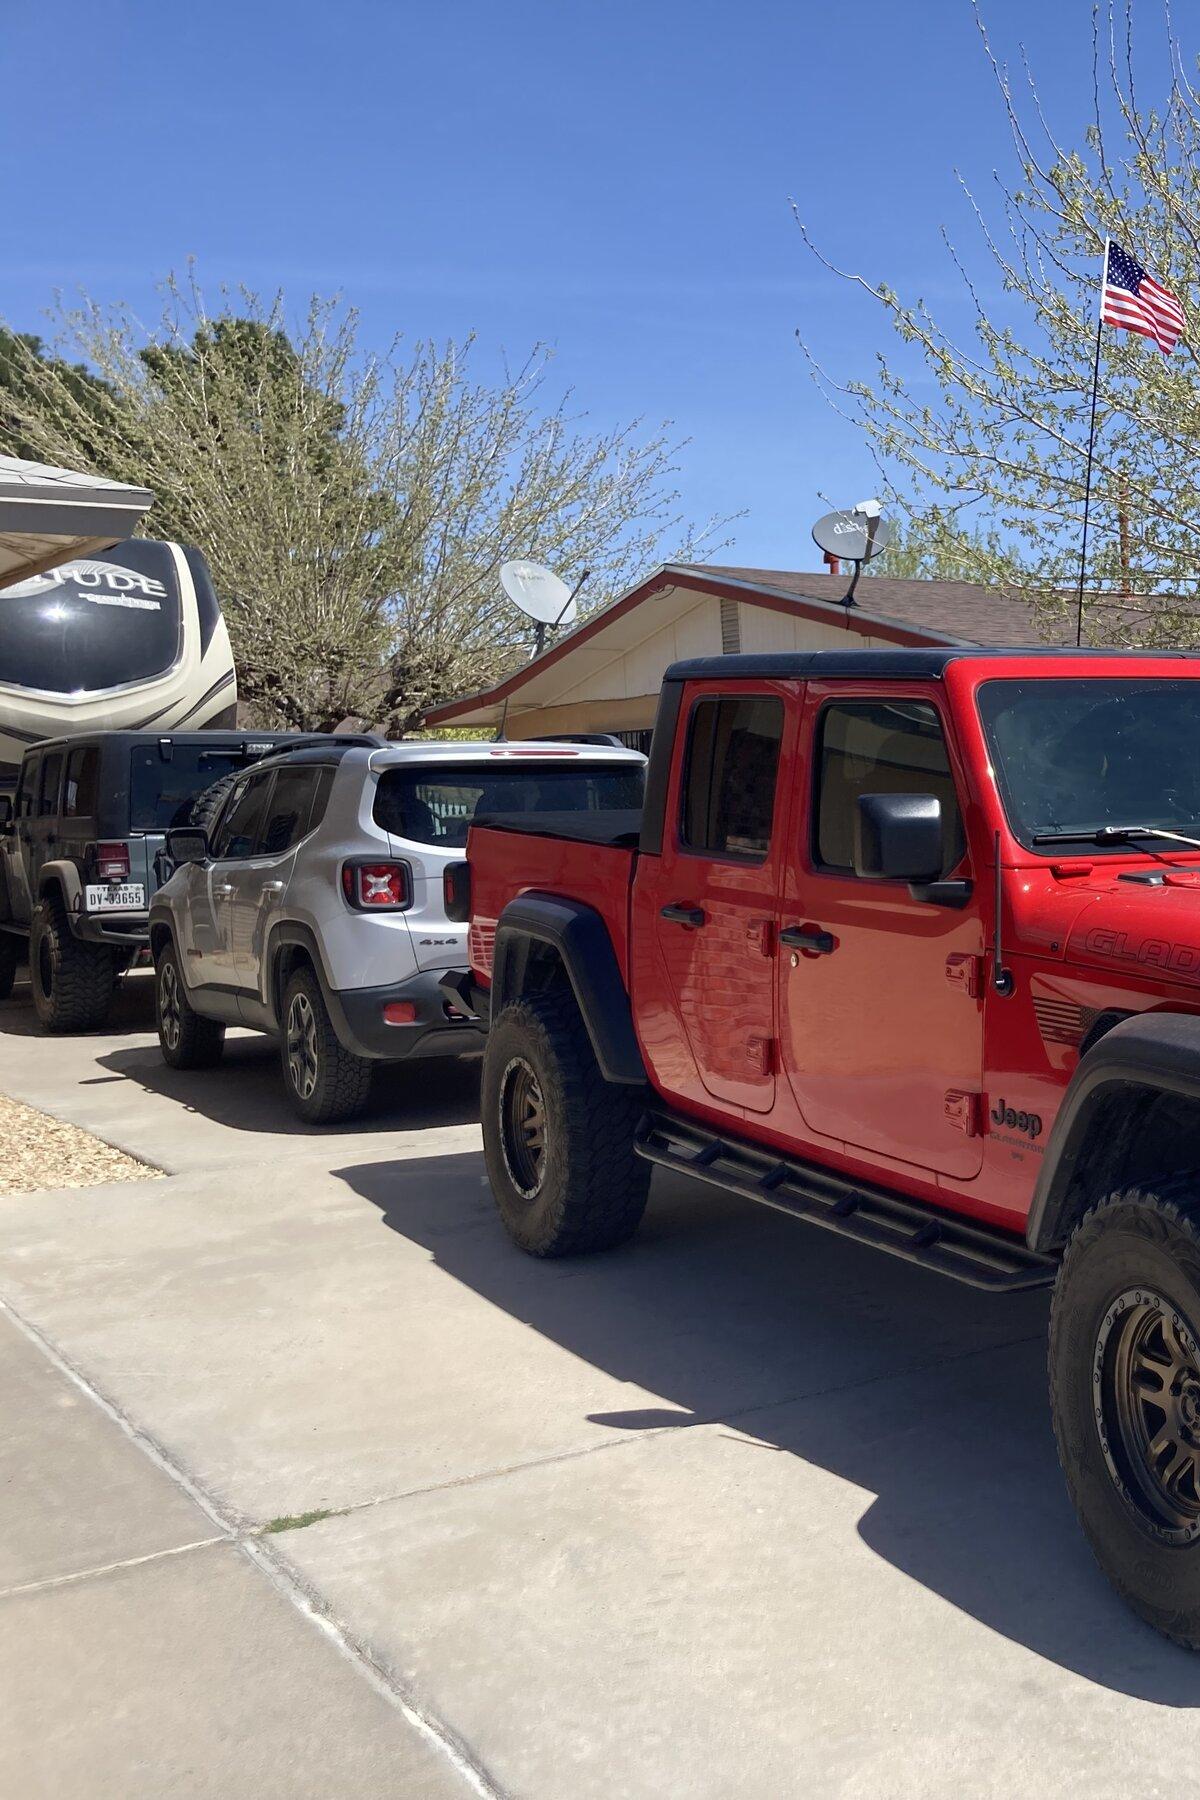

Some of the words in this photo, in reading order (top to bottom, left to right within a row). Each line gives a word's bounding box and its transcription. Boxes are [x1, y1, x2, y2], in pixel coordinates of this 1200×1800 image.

[834, 523, 859, 535] dish
[90, 893, 103, 905] DV
[420, 938, 458, 946] 4x4
[991, 1098, 1042, 1140] Jeep
